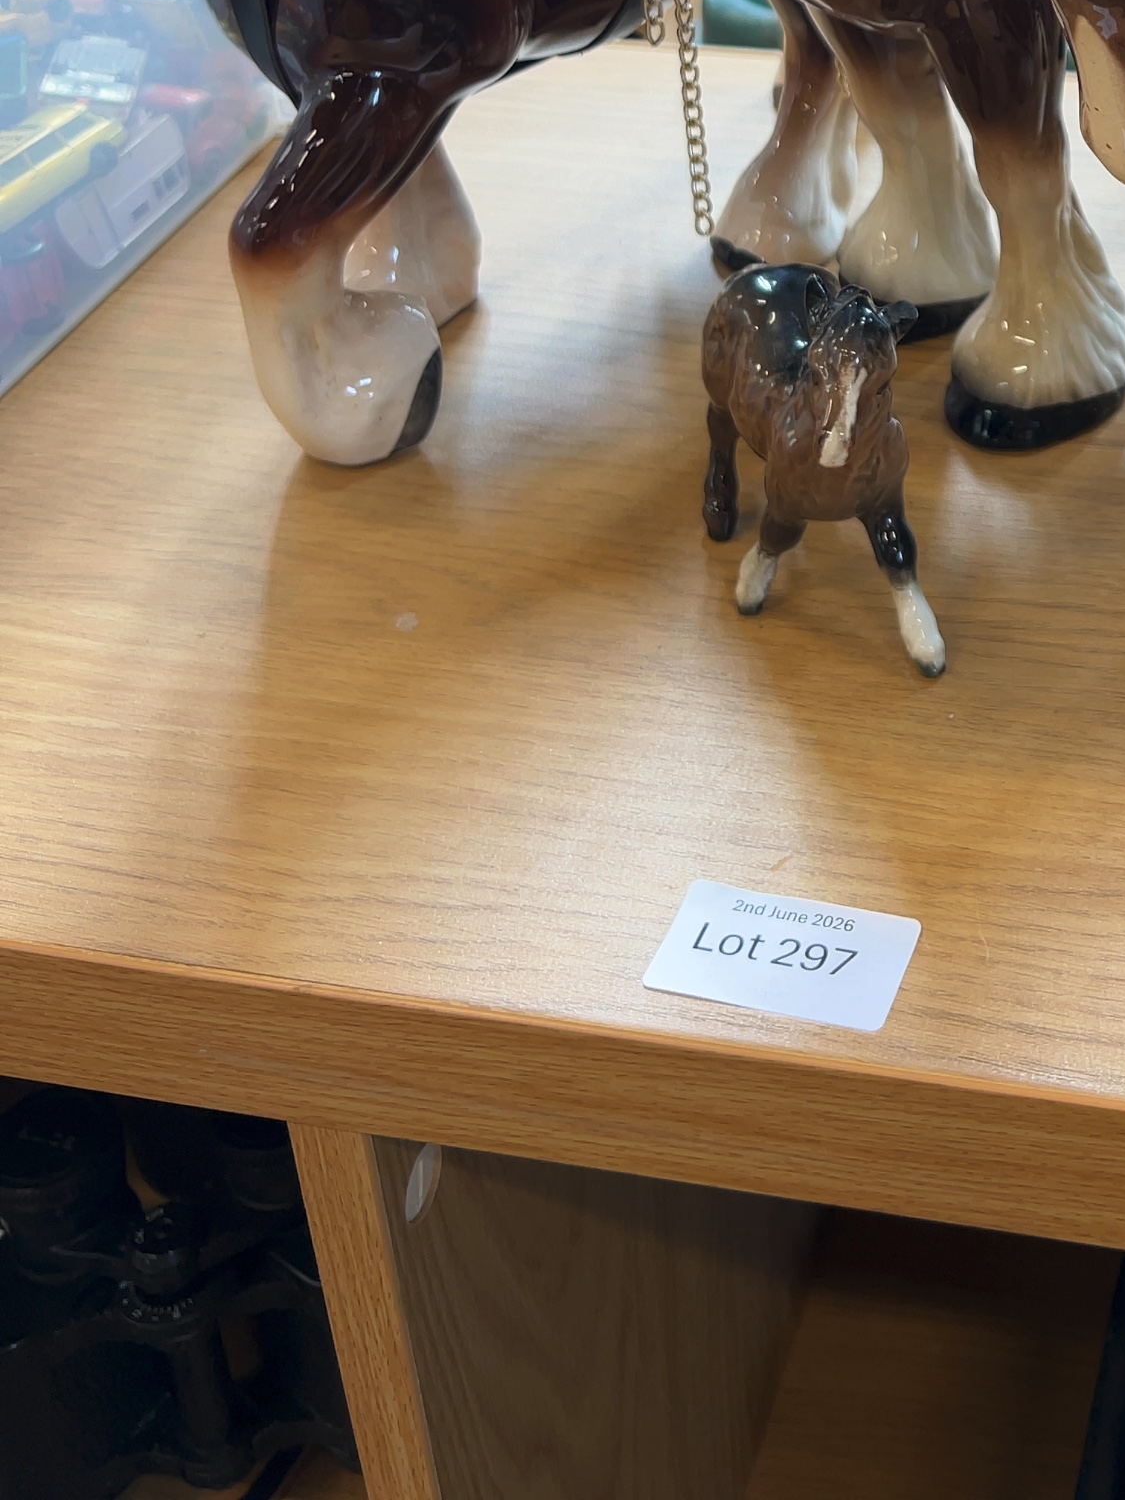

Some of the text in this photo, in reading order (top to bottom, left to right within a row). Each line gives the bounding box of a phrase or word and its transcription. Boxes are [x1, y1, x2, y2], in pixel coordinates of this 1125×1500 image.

[732, 899, 856, 932] 2nd June 2026
[692, 921, 859, 975] Lot 297
